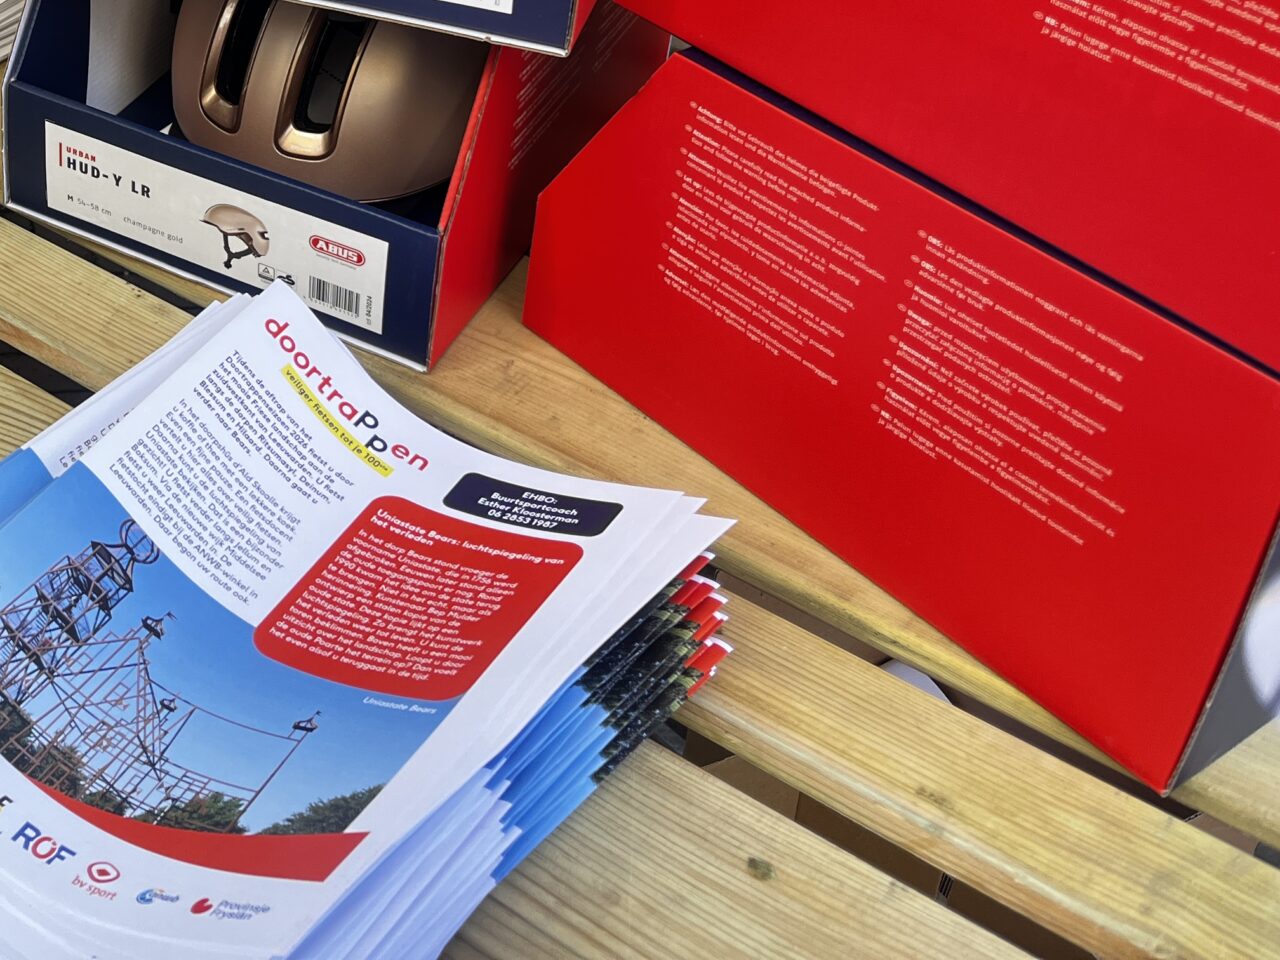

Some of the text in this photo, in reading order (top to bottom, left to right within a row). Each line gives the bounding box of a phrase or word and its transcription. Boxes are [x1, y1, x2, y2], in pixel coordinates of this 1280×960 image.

[67, 146, 96, 162] URBAN
[67, 157, 150, 198] HUD-Y LR
[102, 208, 111, 216] cm
[124, 216, 164, 237] champagne
[167, 234, 183, 244] gold
[316, 240, 358, 261] ABUS
[233, 350, 312, 441] Tijdens de aftrap van het
[265, 318, 429, 471] doortrappen
[286, 370, 313, 402] veiliger
[313, 403, 339, 433] fietsen
[340, 432, 355, 450] tot
[352, 446, 362, 454] je
[193, 387, 250, 456] verder naar Bears.
[199, 380, 226, 412] Blessum
[226, 412, 235, 423] en
[235, 422, 262, 452] Hilaard.
[263, 453, 291, 482] Daarna
[290, 482, 311, 499] gaat
[206, 374, 224, 396] langs
[224, 396, 234, 407] de
[234, 408, 258, 435] dorpen
[299, 475, 330, 504] Deinum,
[212, 369, 344, 501] zuidwestkant van Leeuwarden. U fietst
[219, 362, 335, 484] het mooie Friese landschap aan de
[225, 356, 290, 431] Doortrappenseizoen
[290, 430, 308, 449] 2026
[308, 448, 328, 466] fietst
[334, 472, 354, 486] door
[179, 398, 187, 408] In
[187, 407, 200, 422] het
[252, 481, 279, 507] Skoalle
[279, 506, 301, 525] krijgt
[478, 497, 579, 525] Esther Kloosterman
[488, 509, 558, 528] 06 2853 1987
[491, 492, 578, 516] Buurtsportcoach
[522, 492, 558, 504] EHBO:
[109, 464, 248, 604] Leeuwarden. Daar begon uw route ook.
[371, 516, 433, 546] het verleden
[377, 509, 426, 534] Uniastate
[429, 530, 460, 545] Bears:
[462, 541, 542, 564] luchtspiegeling
[445, 570, 459, 578] die
[471, 576, 491, 584] 1756
[363, 697, 437, 713] Uniastate Bears
[11, 821, 76, 864] ROF
[72, 875, 117, 900] bv sport
